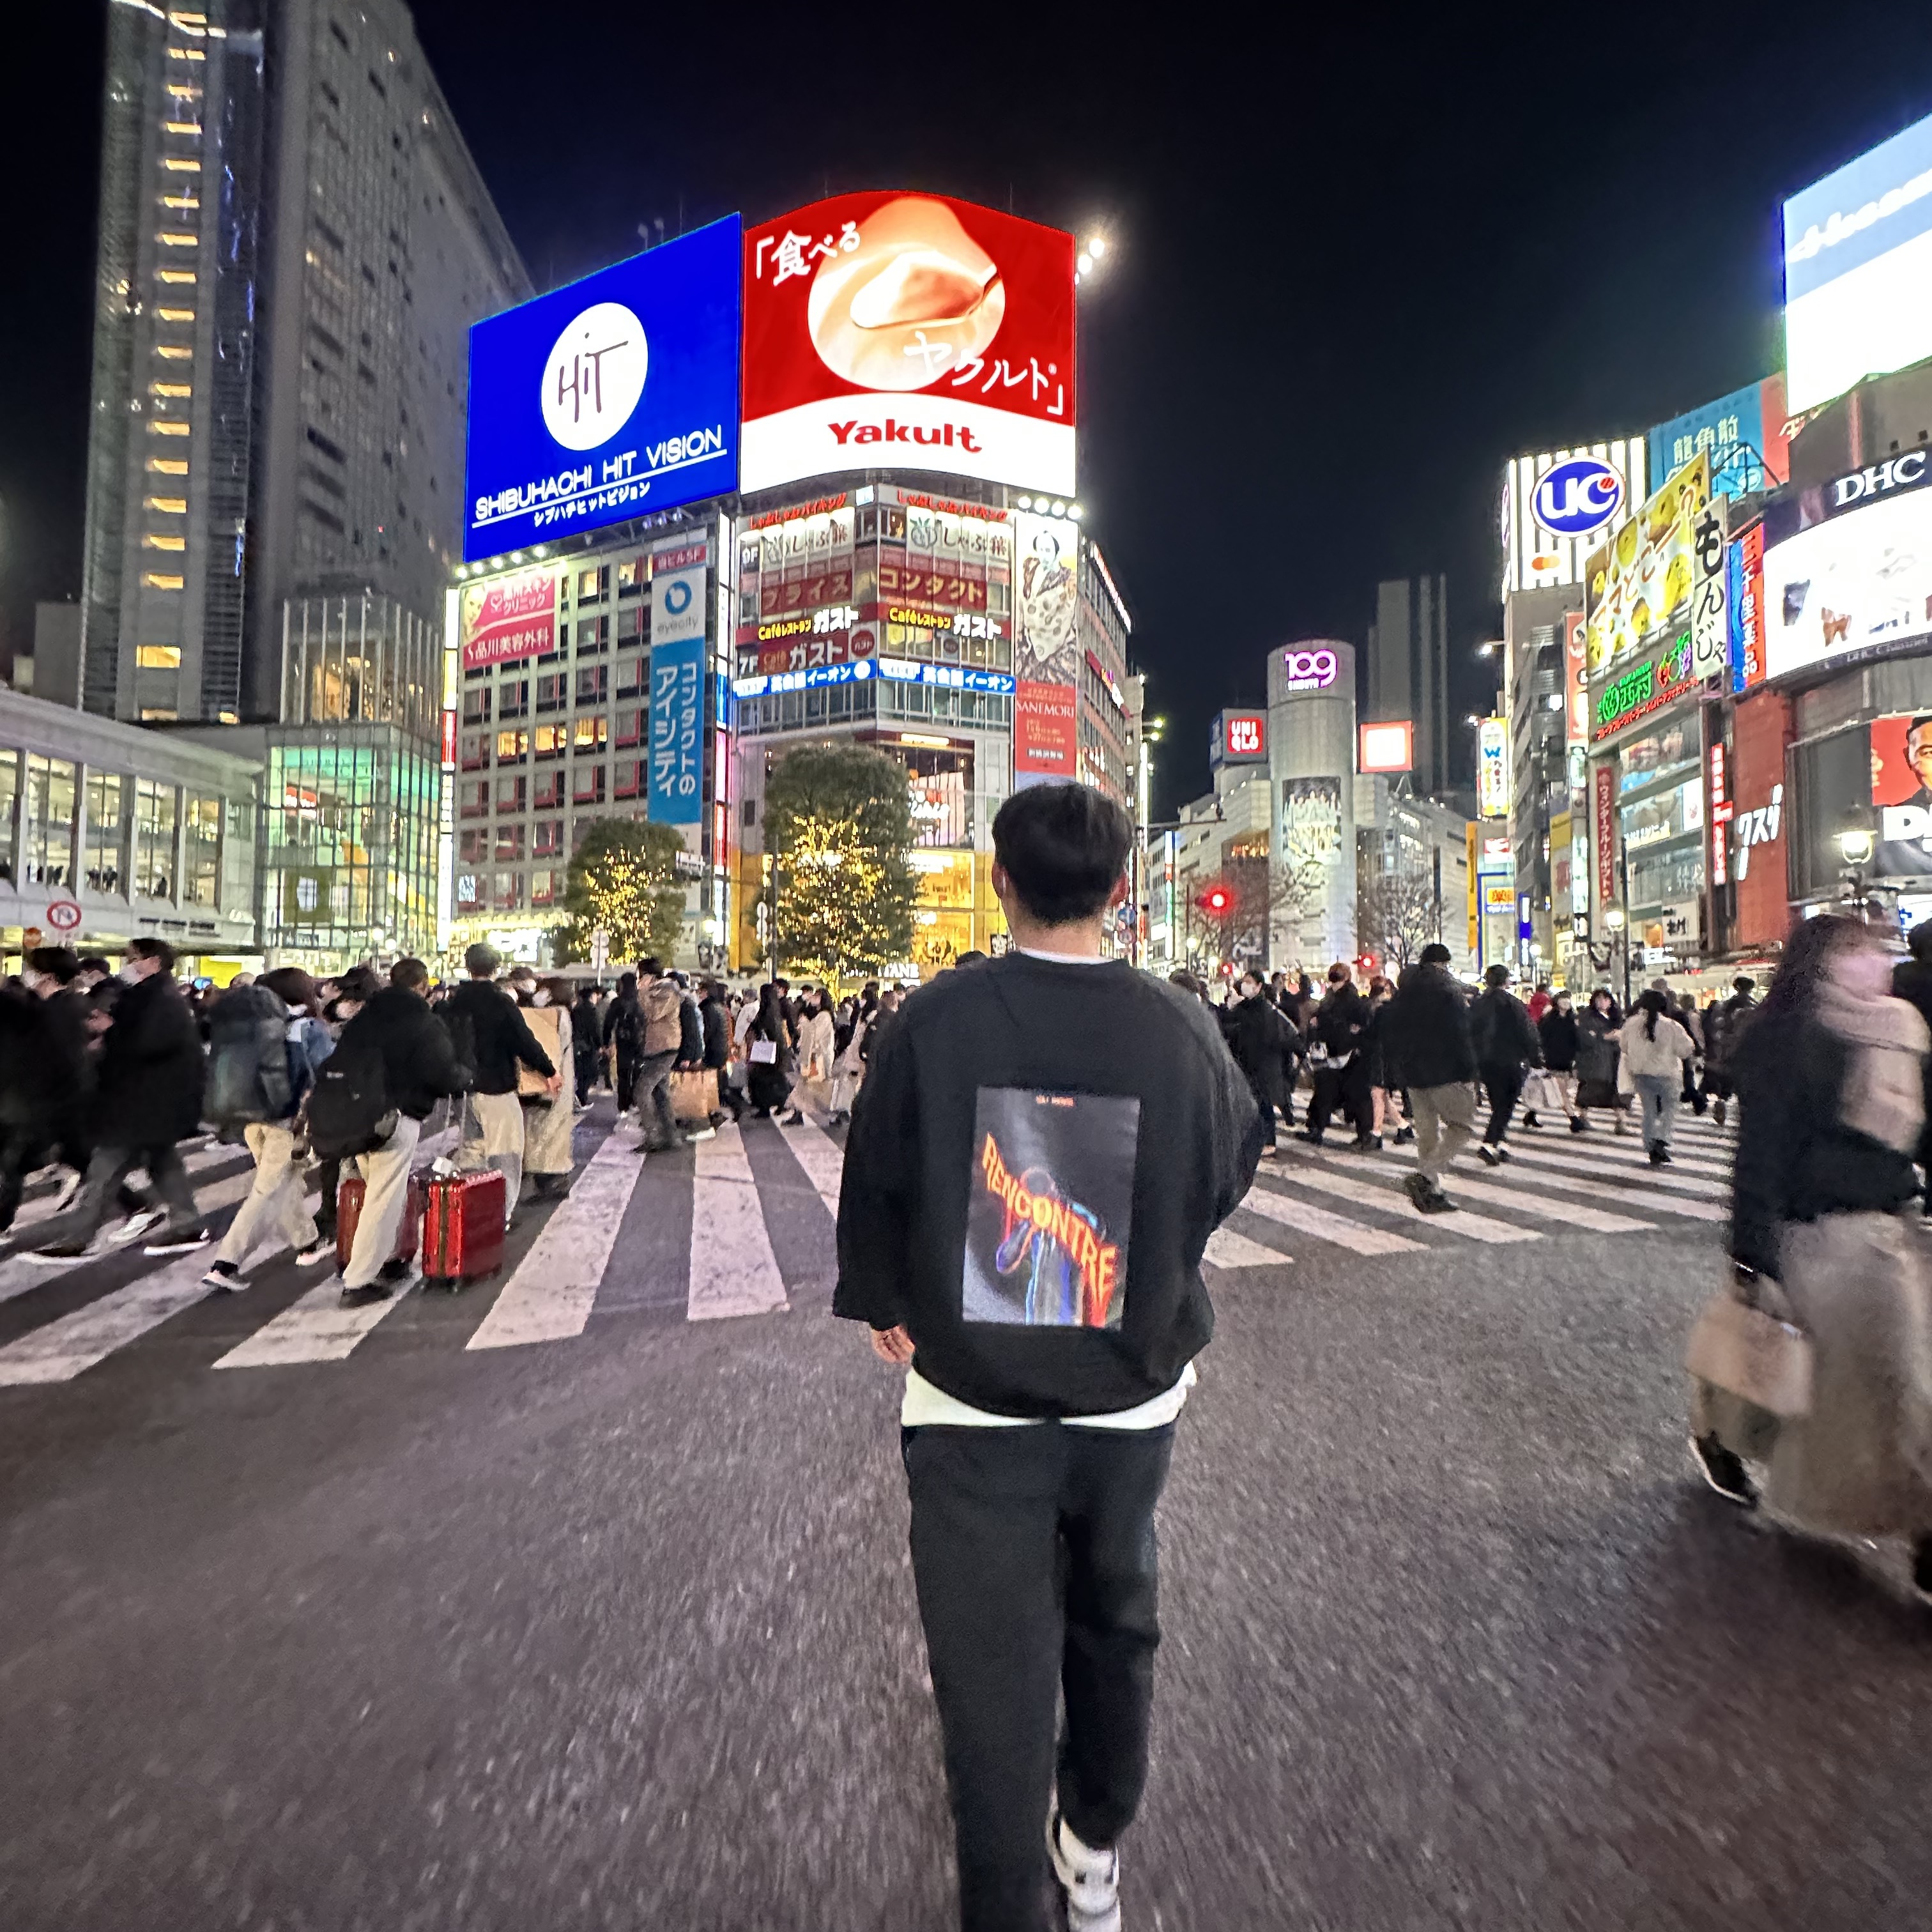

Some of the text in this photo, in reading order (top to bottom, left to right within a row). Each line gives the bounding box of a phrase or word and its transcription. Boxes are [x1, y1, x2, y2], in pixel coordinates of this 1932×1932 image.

[827, 418, 983, 454] Yakult
[475, 424, 723, 521] SHIBUHACHI HIT VISION
[1835, 449, 1927, 508] DHC
[533, 481, 650, 528] シブハチヒットビジョン
[1536, 475, 1616, 520] UC
[502, 592, 546, 614] クリニック
[880, 567, 983, 603] コンタクト
[1695, 510, 1726, 664] もんじゃ
[813, 605, 859, 634] ガスト
[953, 613, 1002, 640] ガスト
[788, 639, 843, 671] ガスト
[1284, 648, 1338, 688] 109
[1230, 721, 1257, 735] UNI
[1231, 735, 1260, 753] QLO
[1737, 783, 1784, 881] クスリ
[982, 1130, 1118, 1303] RENCONTRE
